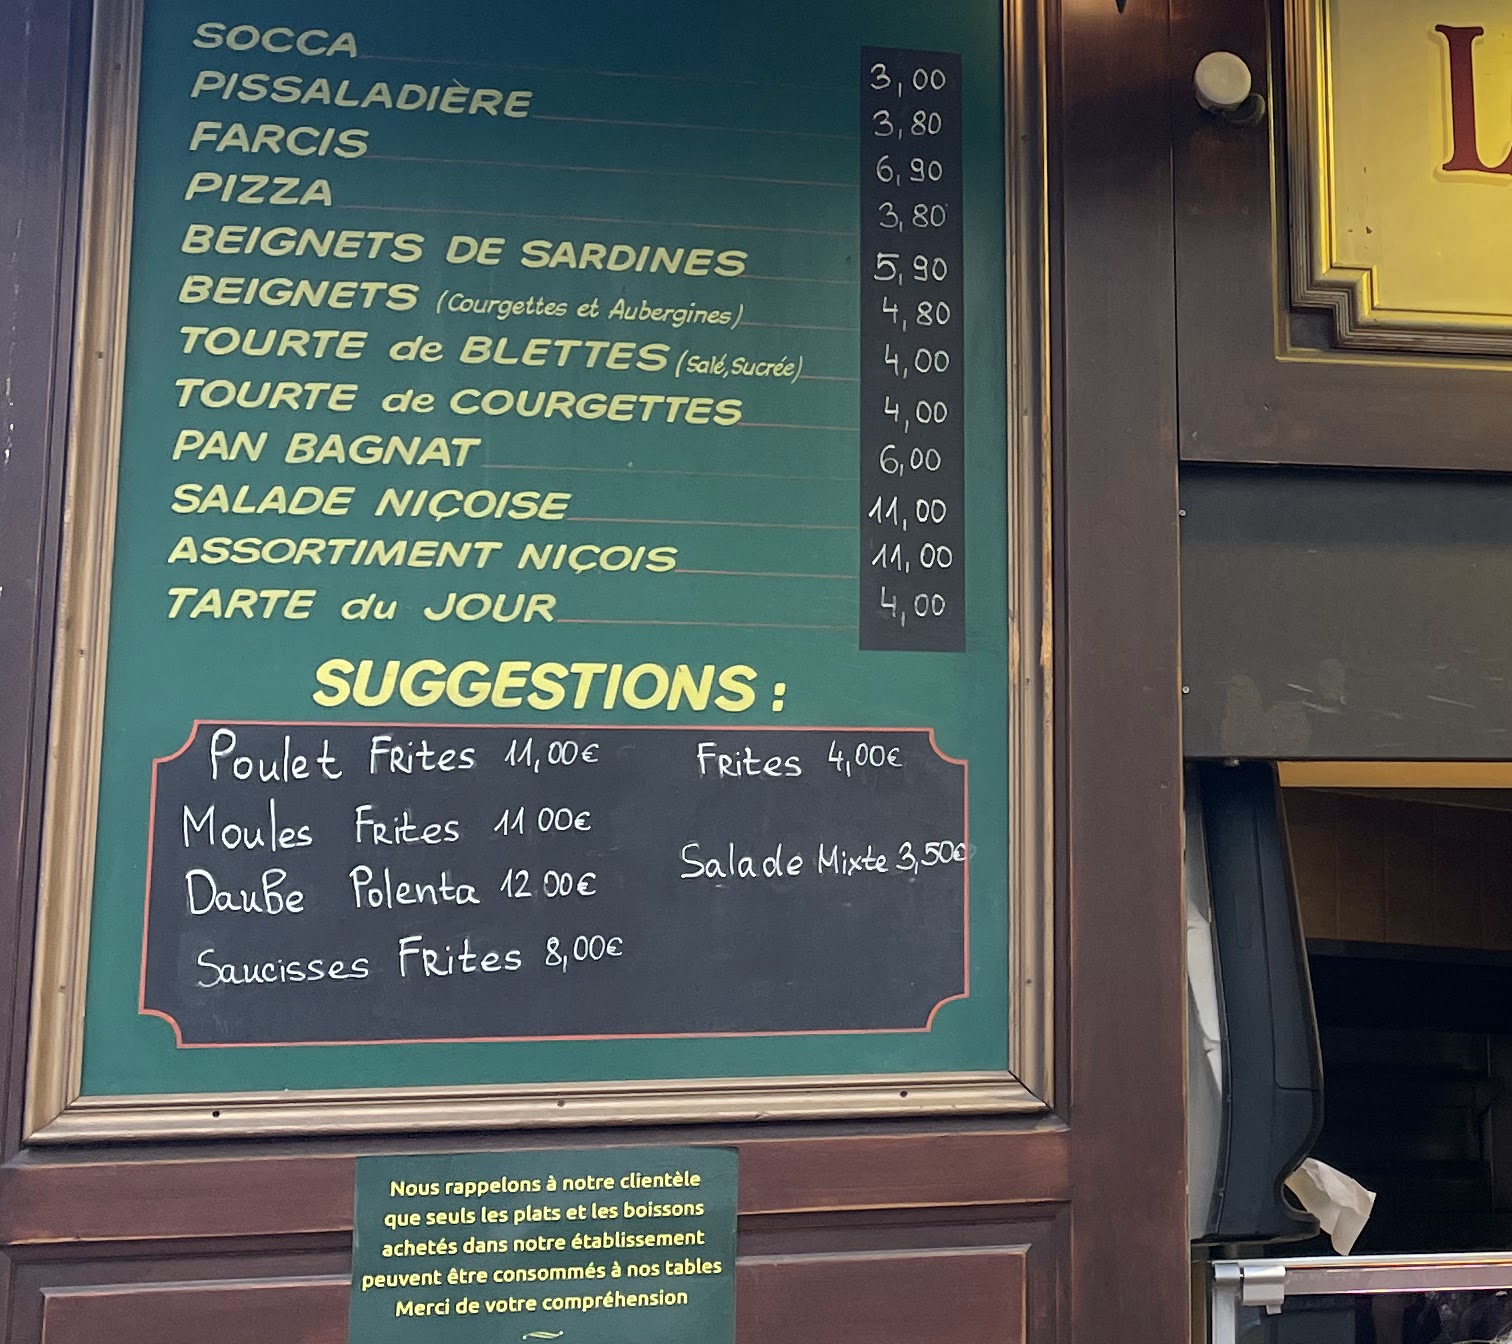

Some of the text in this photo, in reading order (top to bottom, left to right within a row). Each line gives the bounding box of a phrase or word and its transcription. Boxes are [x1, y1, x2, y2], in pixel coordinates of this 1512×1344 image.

[193, 22, 947, 98] SOCCA 3,00
[191, 70, 943, 141] PISSALADIÈRE 3,80
[189, 121, 943, 187] FARCIS 6,90
[184, 171, 947, 232] PIZZA 3,80
[180, 223, 948, 286] BEIGNETS DE SARDINES 5,90
[178, 274, 951, 333] BEIGNETS (Courgettes et Aubergines) 4,80
[180, 326, 368, 360] TOURTE
[389, 336, 445, 363] de
[459, 336, 670, 372] BLETTES
[885, 343, 950, 380] 4,00
[175, 378, 948, 434] TOURTE de COURGETTES 4,00
[172, 429, 941, 477] PAN BAGNAT 6,00
[171, 483, 947, 532] SALADE NIÇOISE 11,00
[167, 535, 953, 576] ASSORTIMENT NIÇOIS 11,00
[167, 586, 946, 628] TARTE du JOUR 4,00
[312, 658, 758, 713] SUGGESTIONS
[211, 728, 343, 782] Poulet
[182, 798, 313, 851] Moules
[680, 840, 803, 879] Salade
[817, 843, 889, 878] Mixte
[349, 865, 481, 909] Polenta
[196, 948, 370, 988] Saucisses
[390, 1170, 701, 1198] Nous rappelons à notre clientèle
[384, 1201, 704, 1230] que seuls les plats et les boissons
[382, 1230, 705, 1257] achetés dans notre établissement
[361, 1257, 722, 1291] peuvent être consommés à nos tables
[395, 1290, 688, 1317] Merci de votre compréhension
